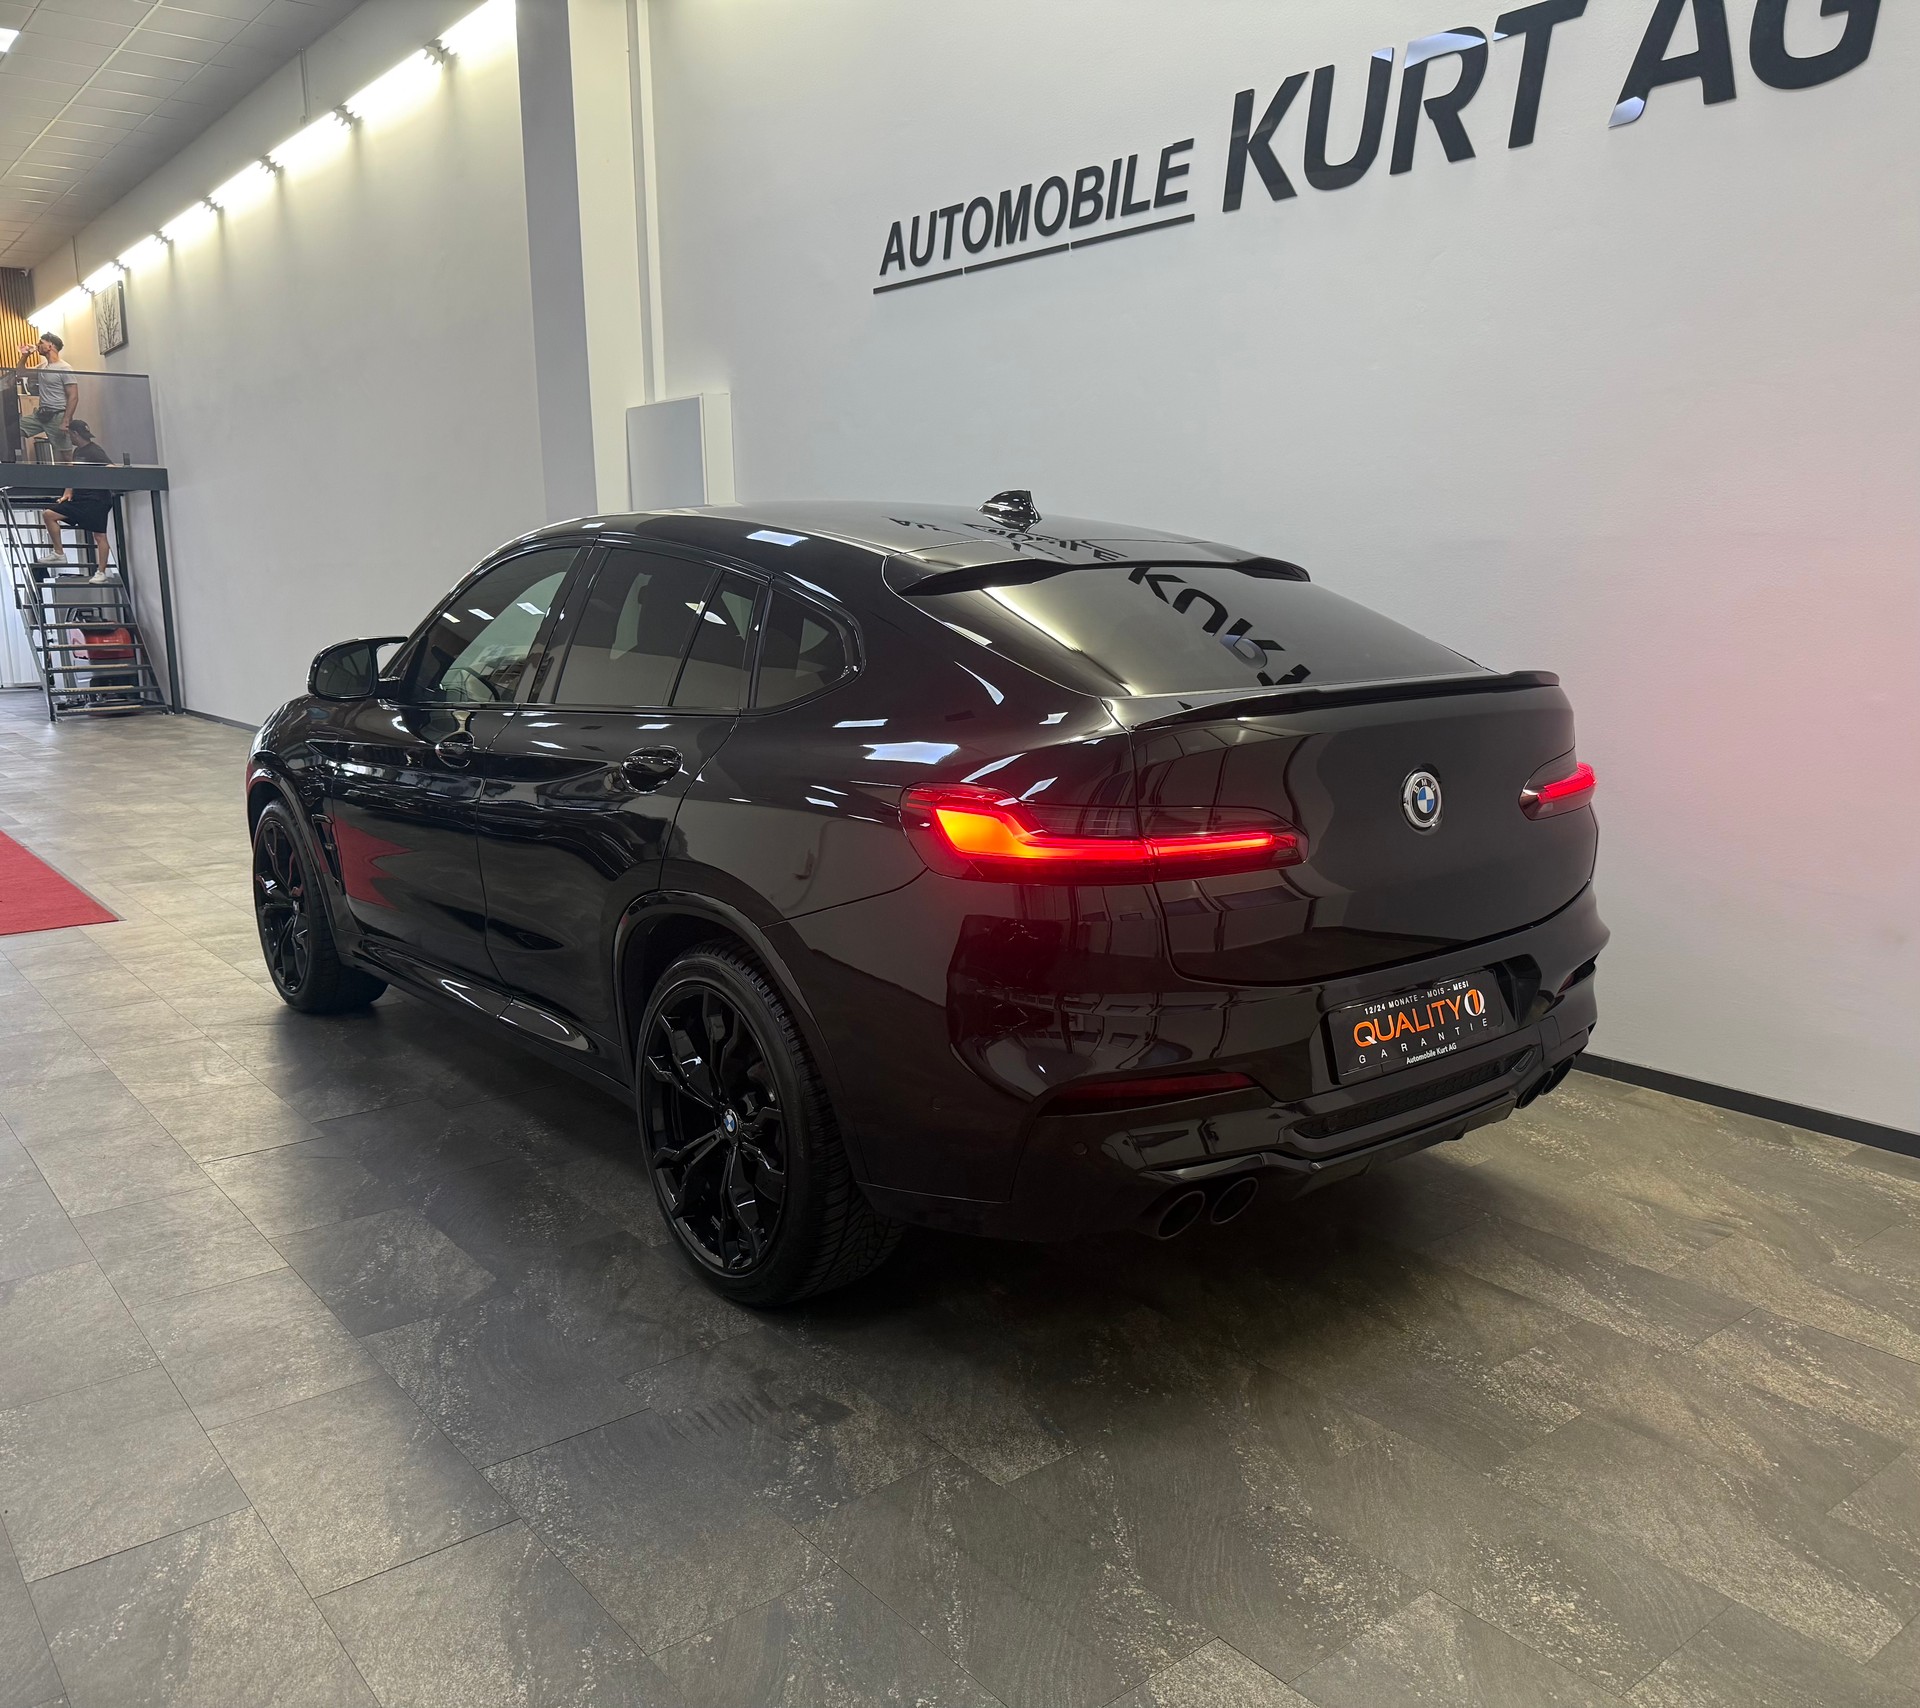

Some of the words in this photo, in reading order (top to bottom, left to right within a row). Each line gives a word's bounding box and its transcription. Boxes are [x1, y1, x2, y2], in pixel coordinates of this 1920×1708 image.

[879, 138, 1195, 276] AUTOMOBILE
[1222, 0, 1589, 213] KURT
[1608, 0, 1882, 128] AG
[1413, 778, 1436, 794] BMW
[1364, 1003, 1386, 1015] 12/24
[1388, 995, 1418, 1009] MONATE
[1427, 987, 1445, 998] MOIS
[1452, 980, 1469, 991] MESI
[1358, 1017, 1488, 1064] GARANTIE
[1406, 1049, 1436, 1065] Automobile
[1436, 1045, 1448, 1056] Kurt
[1448, 1042, 1457, 1053] AG
